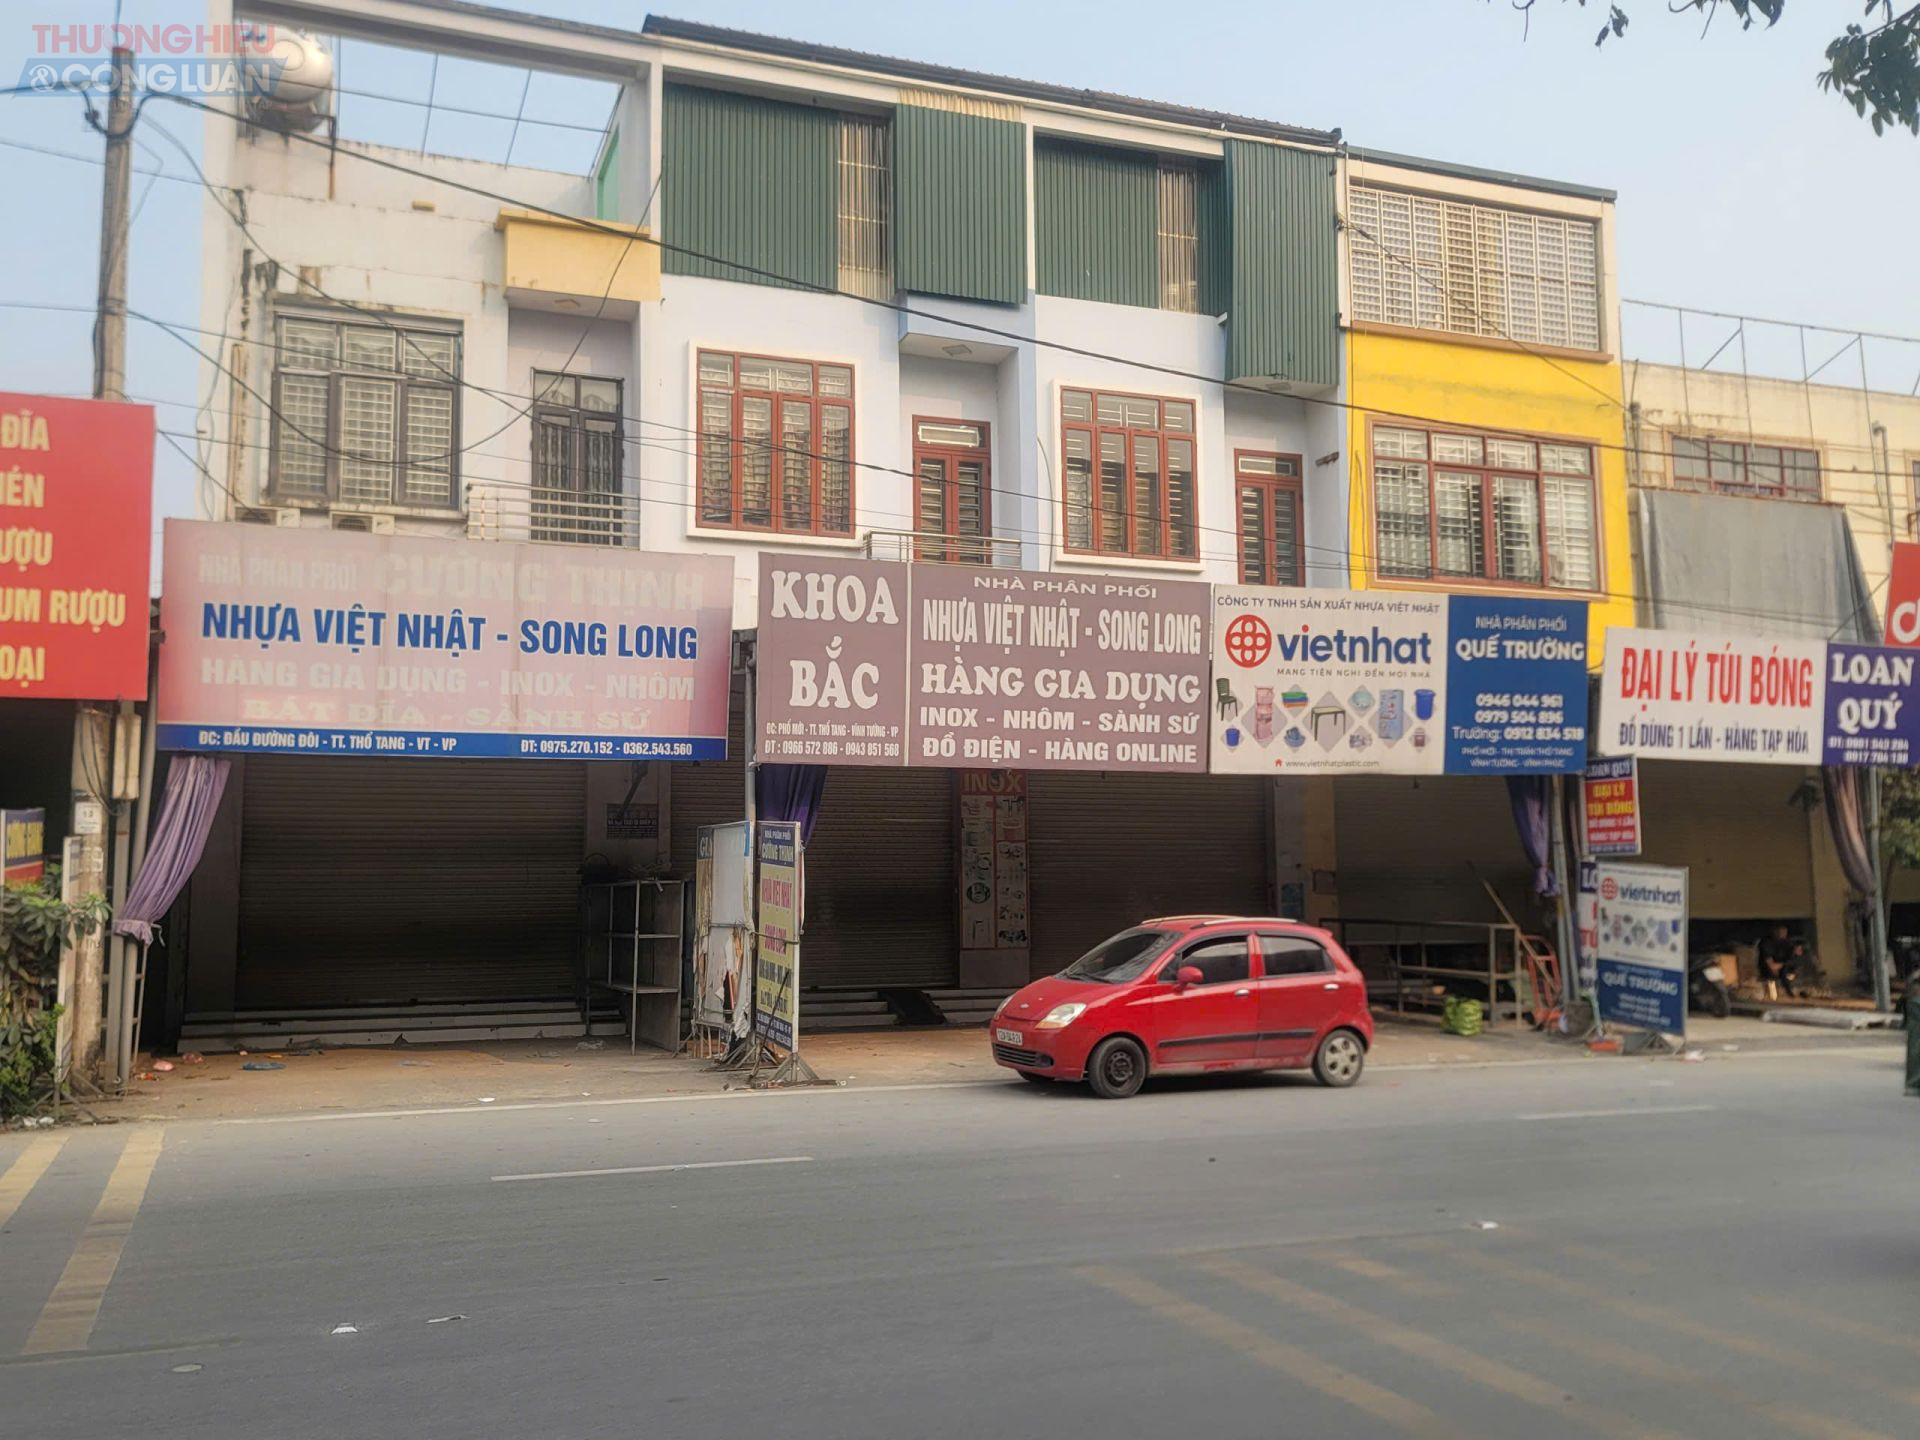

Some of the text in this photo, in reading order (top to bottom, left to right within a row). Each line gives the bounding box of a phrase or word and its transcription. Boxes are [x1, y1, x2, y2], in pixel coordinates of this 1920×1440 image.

[1, 409, 51, 451] ĐĨA
[770, 570, 900, 625] KHOA
[973, 576, 1158, 599] NHÀ PHÂN PHỐI
[1216, 595, 1250, 608] CÔNG
[1250, 597, 1265, 608] TY
[1267, 598, 1298, 610] TNHH
[49, 588, 127, 633] RƯỢU
[202, 602, 698, 660] NHỰA VIỆT NHẬT SONG LONG
[922, 594, 1202, 657] NHỰA VIỆT NHẬT SONG LONG
[1276, 623, 1432, 665] vietnhat
[1455, 634, 1585, 662] QUẾ TRƯỜNG
[201, 655, 696, 701] HÀNG GIA DỤNG INOX NHÔM
[788, 635, 880, 710] BẮC
[920, 656, 1202, 710] HÀNG GIA DỤNG
[1276, 668, 1306, 677] MANG
[1620, 639, 1814, 712] ĐẠI LÝ TÚI BÓNG
[1830, 652, 1915, 687] LOAN
[919, 706, 1201, 735] INOX NHÔM SÀNH SỨ
[1837, 691, 1903, 736] QUÝ
[198, 730, 221, 747] ĐC:
[252, 728, 296, 749] ĐƯỜNG
[298, 731, 320, 749] ĐÔI
[375, 735, 406, 751] TANG
[416, 737, 432, 752] VT
[442, 737, 458, 752] VP
[520, 738, 538, 754] ĐT:
[539, 739, 614, 755] 0975.270.152
[845, 742, 866, 756] 0943
[867, 742, 882, 757] 851
[922, 731, 1198, 764] ĐỒ ĐIỆN HÀNG ONLINE
[1760, 728, 1783, 758] TẠP
